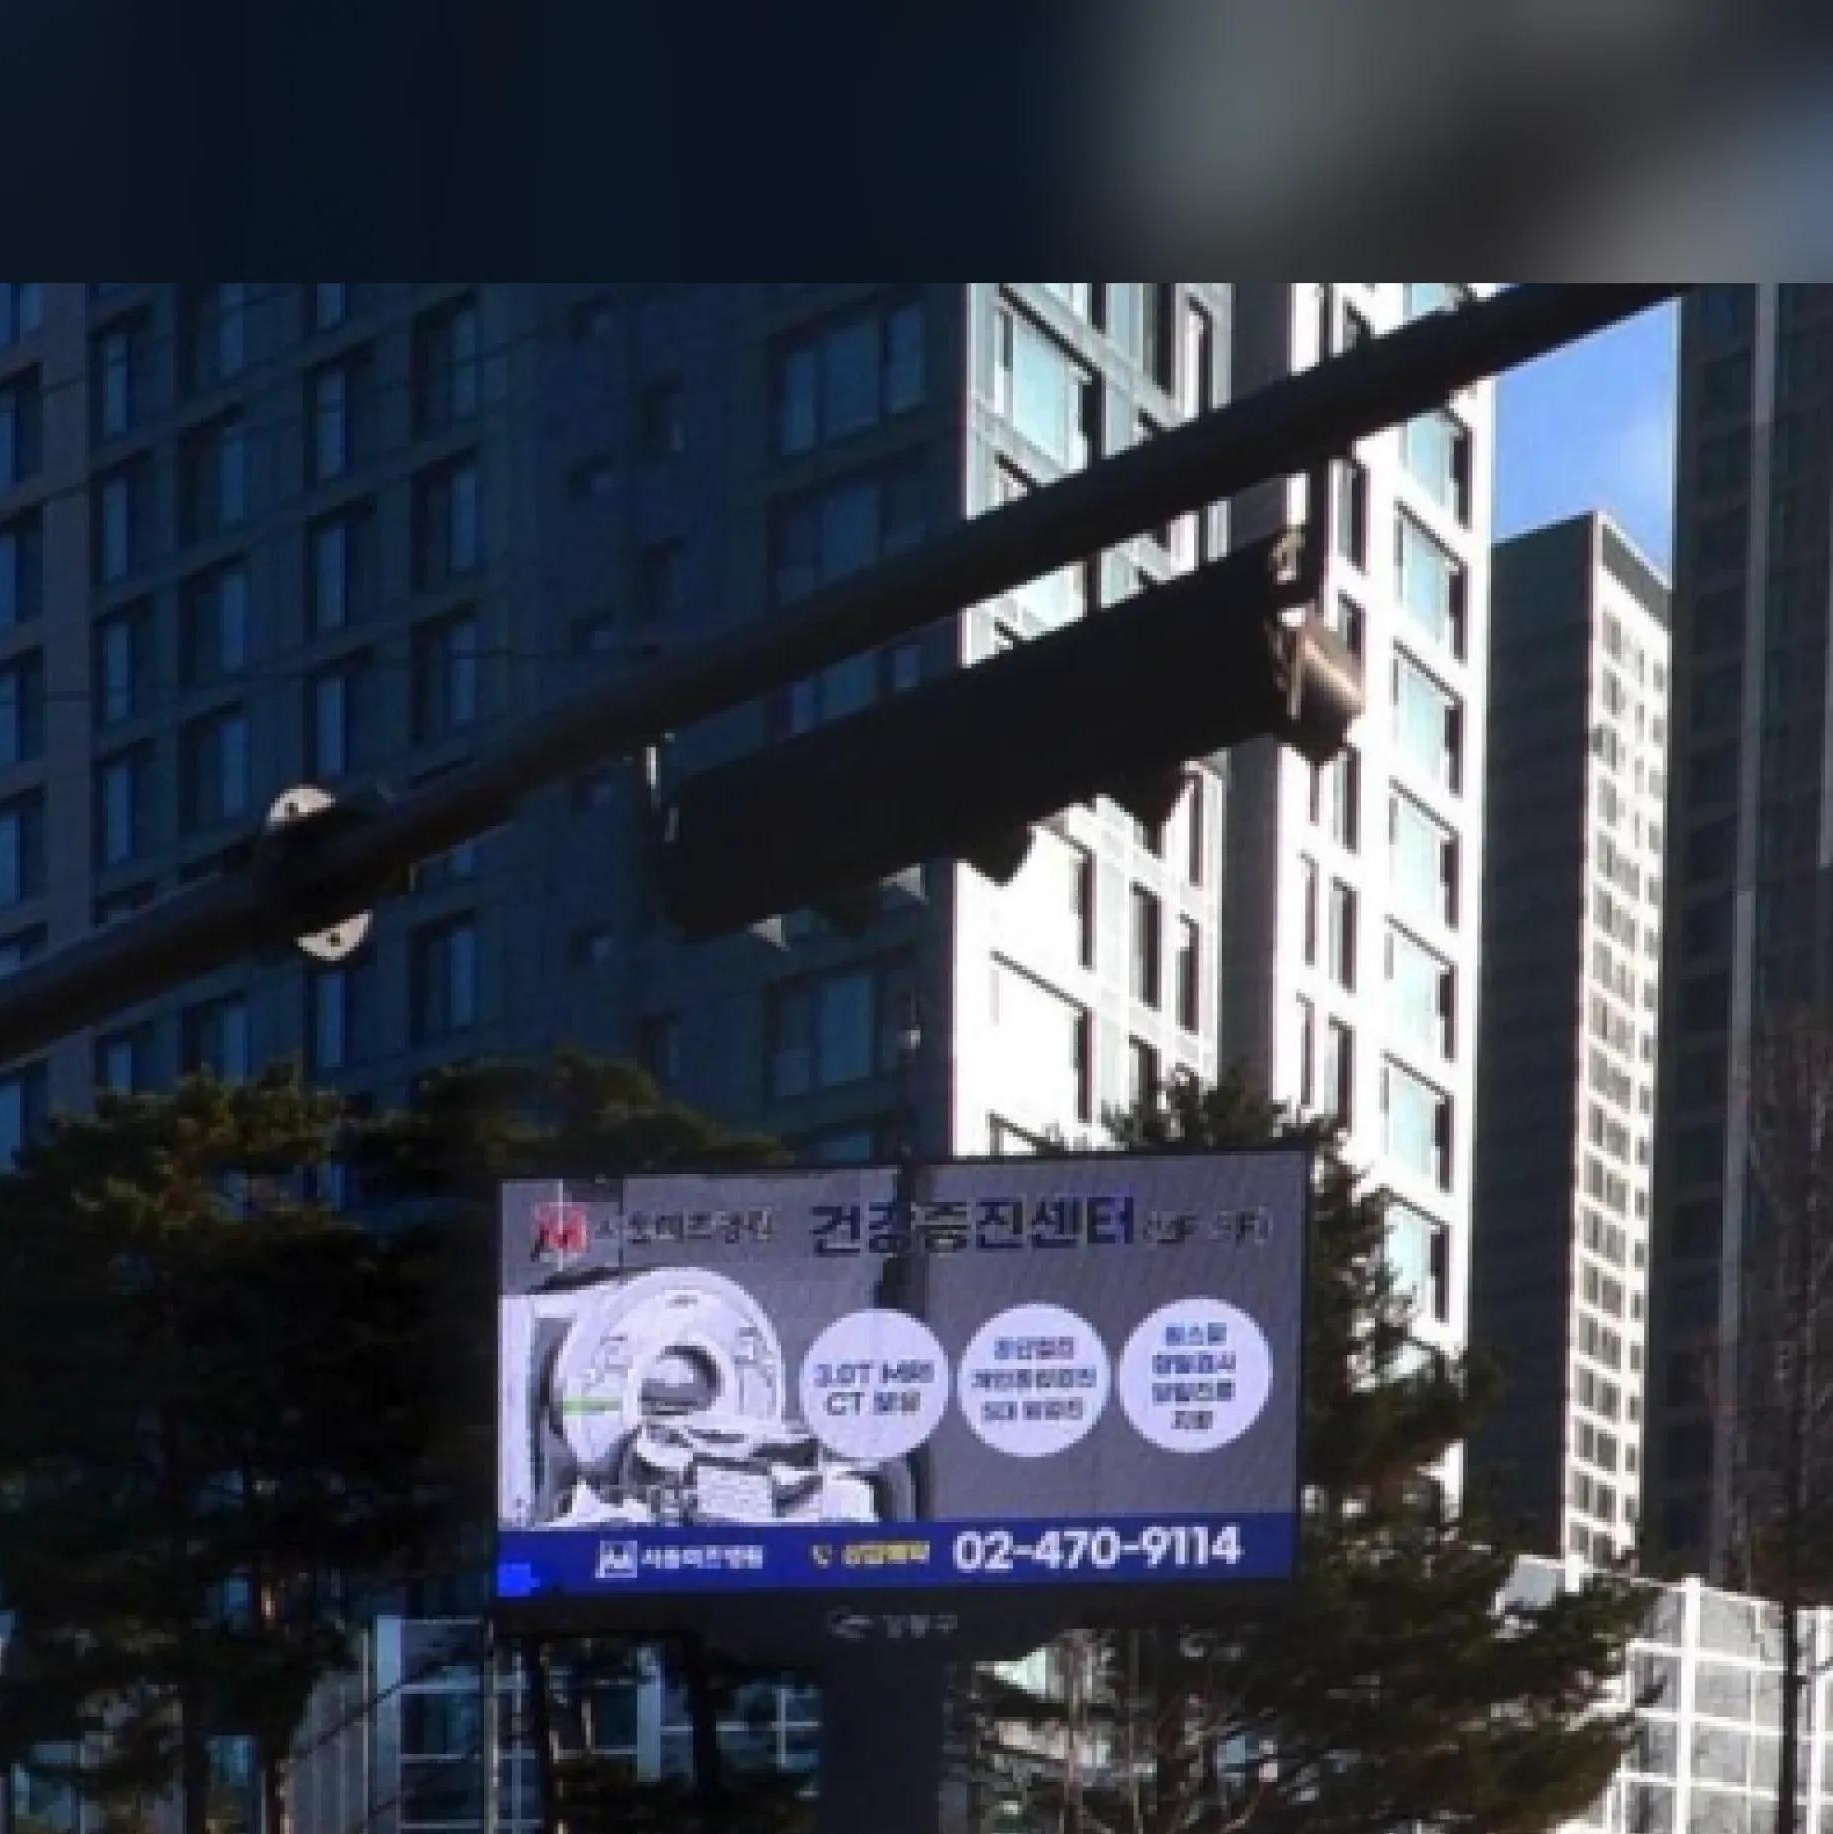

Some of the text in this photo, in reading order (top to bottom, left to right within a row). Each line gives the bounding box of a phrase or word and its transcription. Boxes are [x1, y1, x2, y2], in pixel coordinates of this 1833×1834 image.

[810, 1195, 1135, 1259] 건강증진센터
[826, 1391, 864, 1416] CT
[952, 1526, 1244, 1573] 02-470-9114
